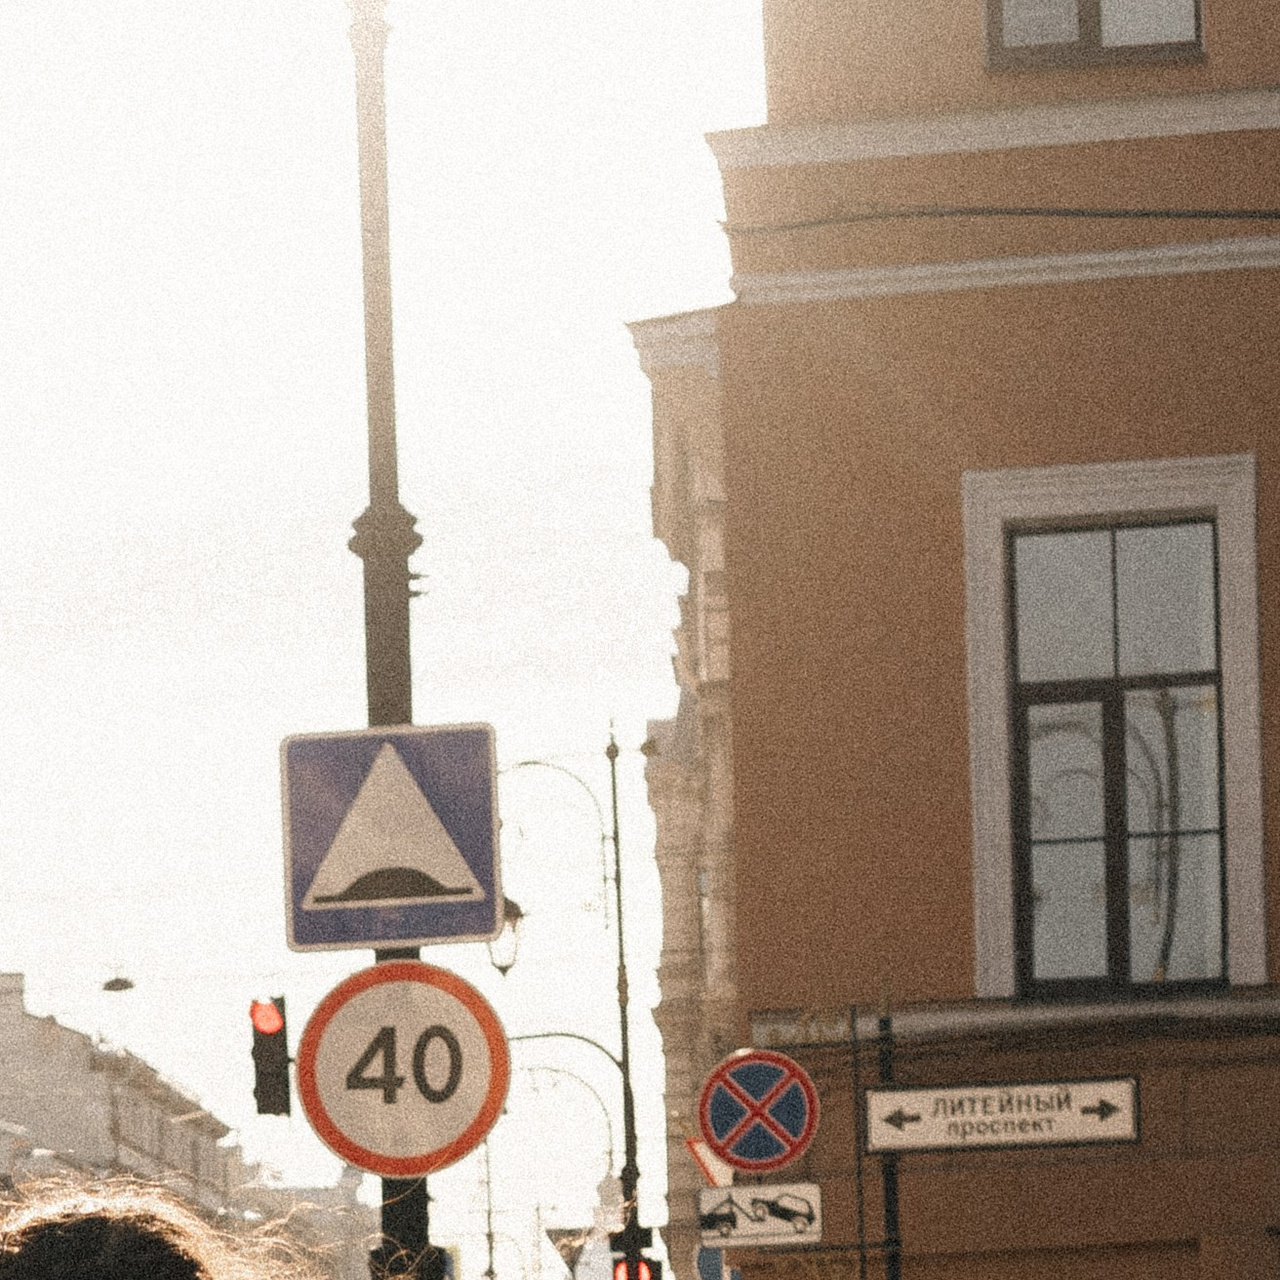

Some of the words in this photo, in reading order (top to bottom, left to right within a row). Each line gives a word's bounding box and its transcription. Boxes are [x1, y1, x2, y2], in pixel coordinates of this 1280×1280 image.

[346, 1024, 462, 1104] 40
[932, 1087, 1074, 1118] ЛИТЕЙНЫЙ
[946, 1117, 1057, 1140] проспект
